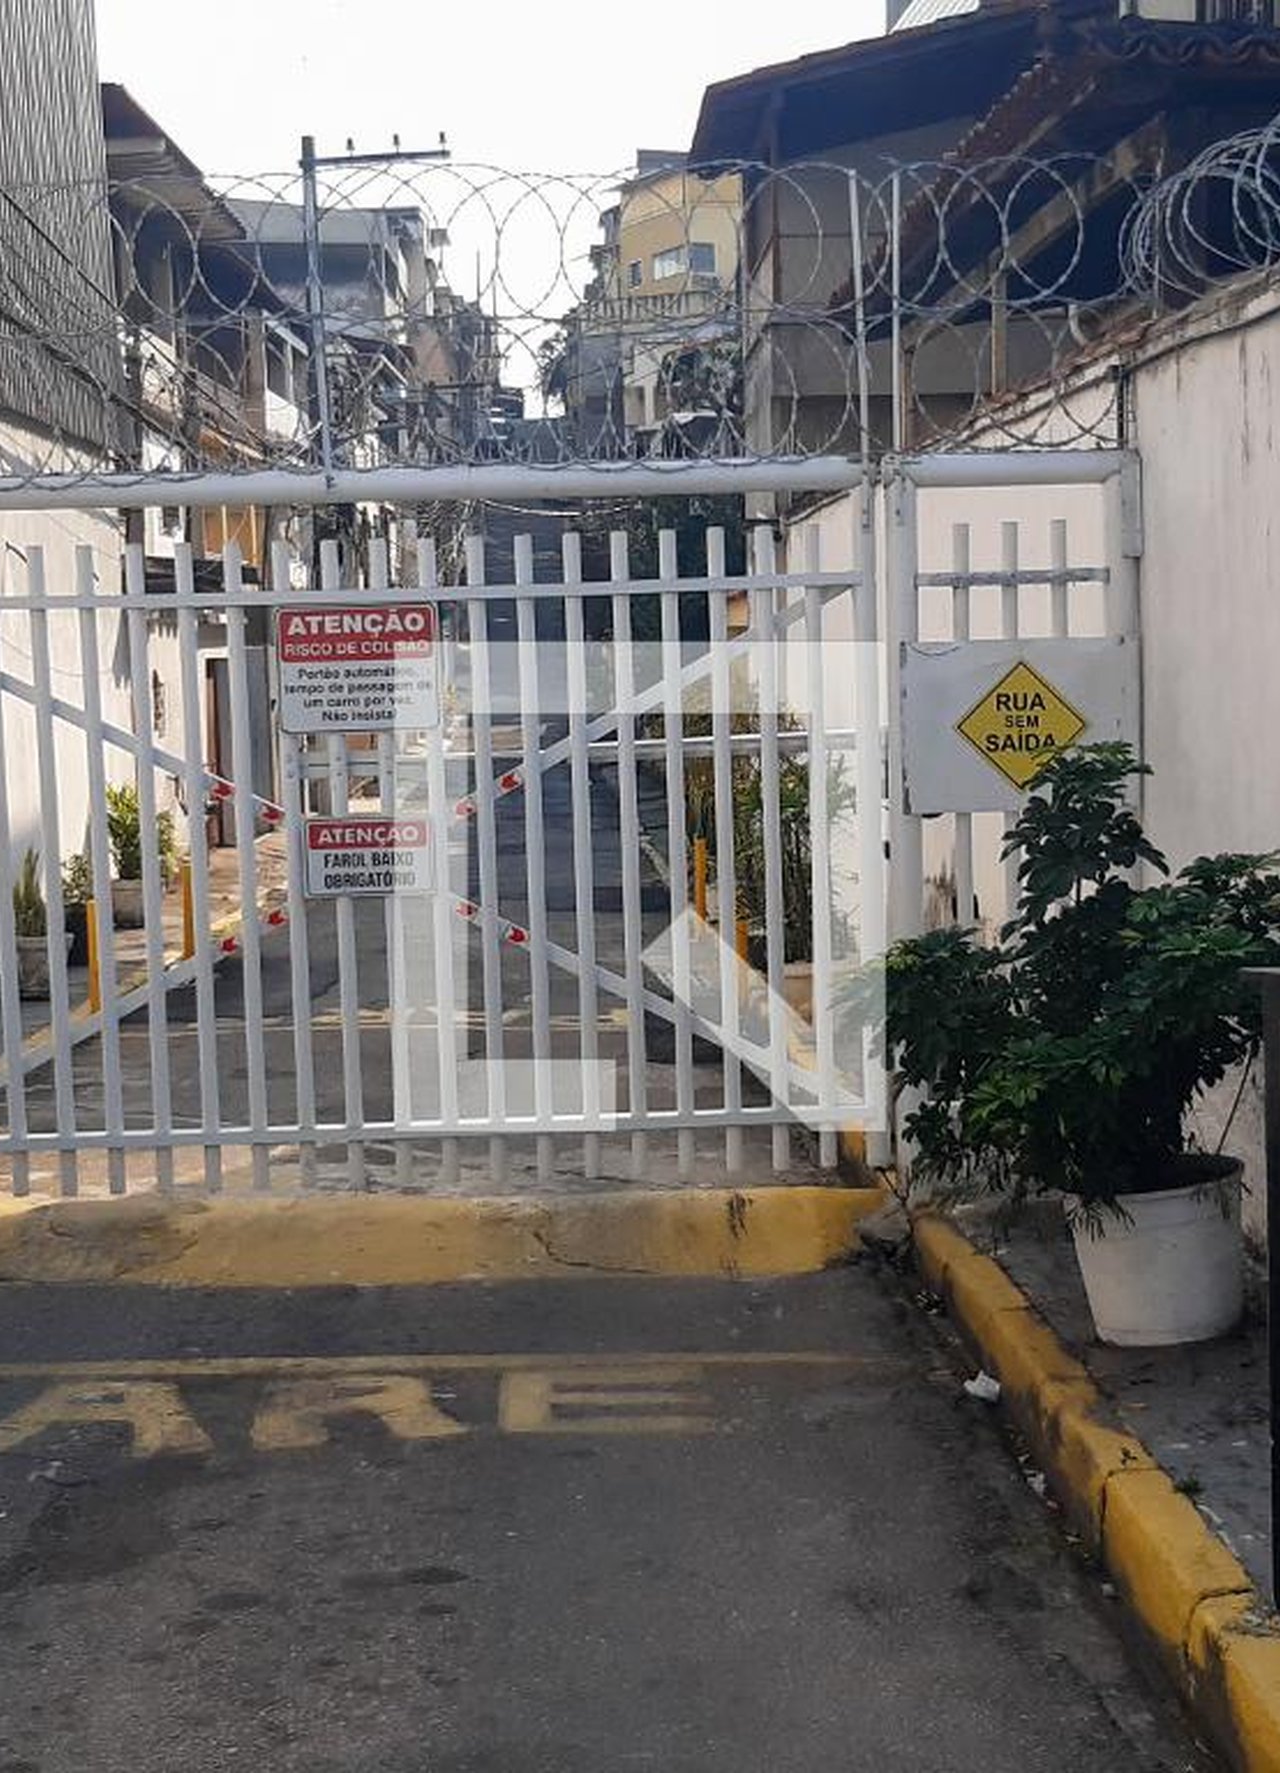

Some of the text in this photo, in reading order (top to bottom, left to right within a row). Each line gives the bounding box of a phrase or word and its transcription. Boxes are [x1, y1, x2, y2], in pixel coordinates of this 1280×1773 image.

[287, 609, 425, 637] ATENÇÃO
[285, 637, 429, 657] RISCO DE COLISÃO
[297, 668, 339, 680] Portão
[284, 684, 325, 696] tempo
[328, 682, 344, 694] de
[303, 698, 324, 709] um
[326, 697, 361, 708] carro
[364, 696, 387, 709] por
[996, 692, 1046, 711] RUA
[322, 709, 349, 721] Não
[1005, 715, 1039, 728] SEM
[985, 730, 1056, 751] SAÍDA
[324, 851, 414, 868] FAROL BAIXO
[324, 871, 415, 888] OBRIGATÓRIO
